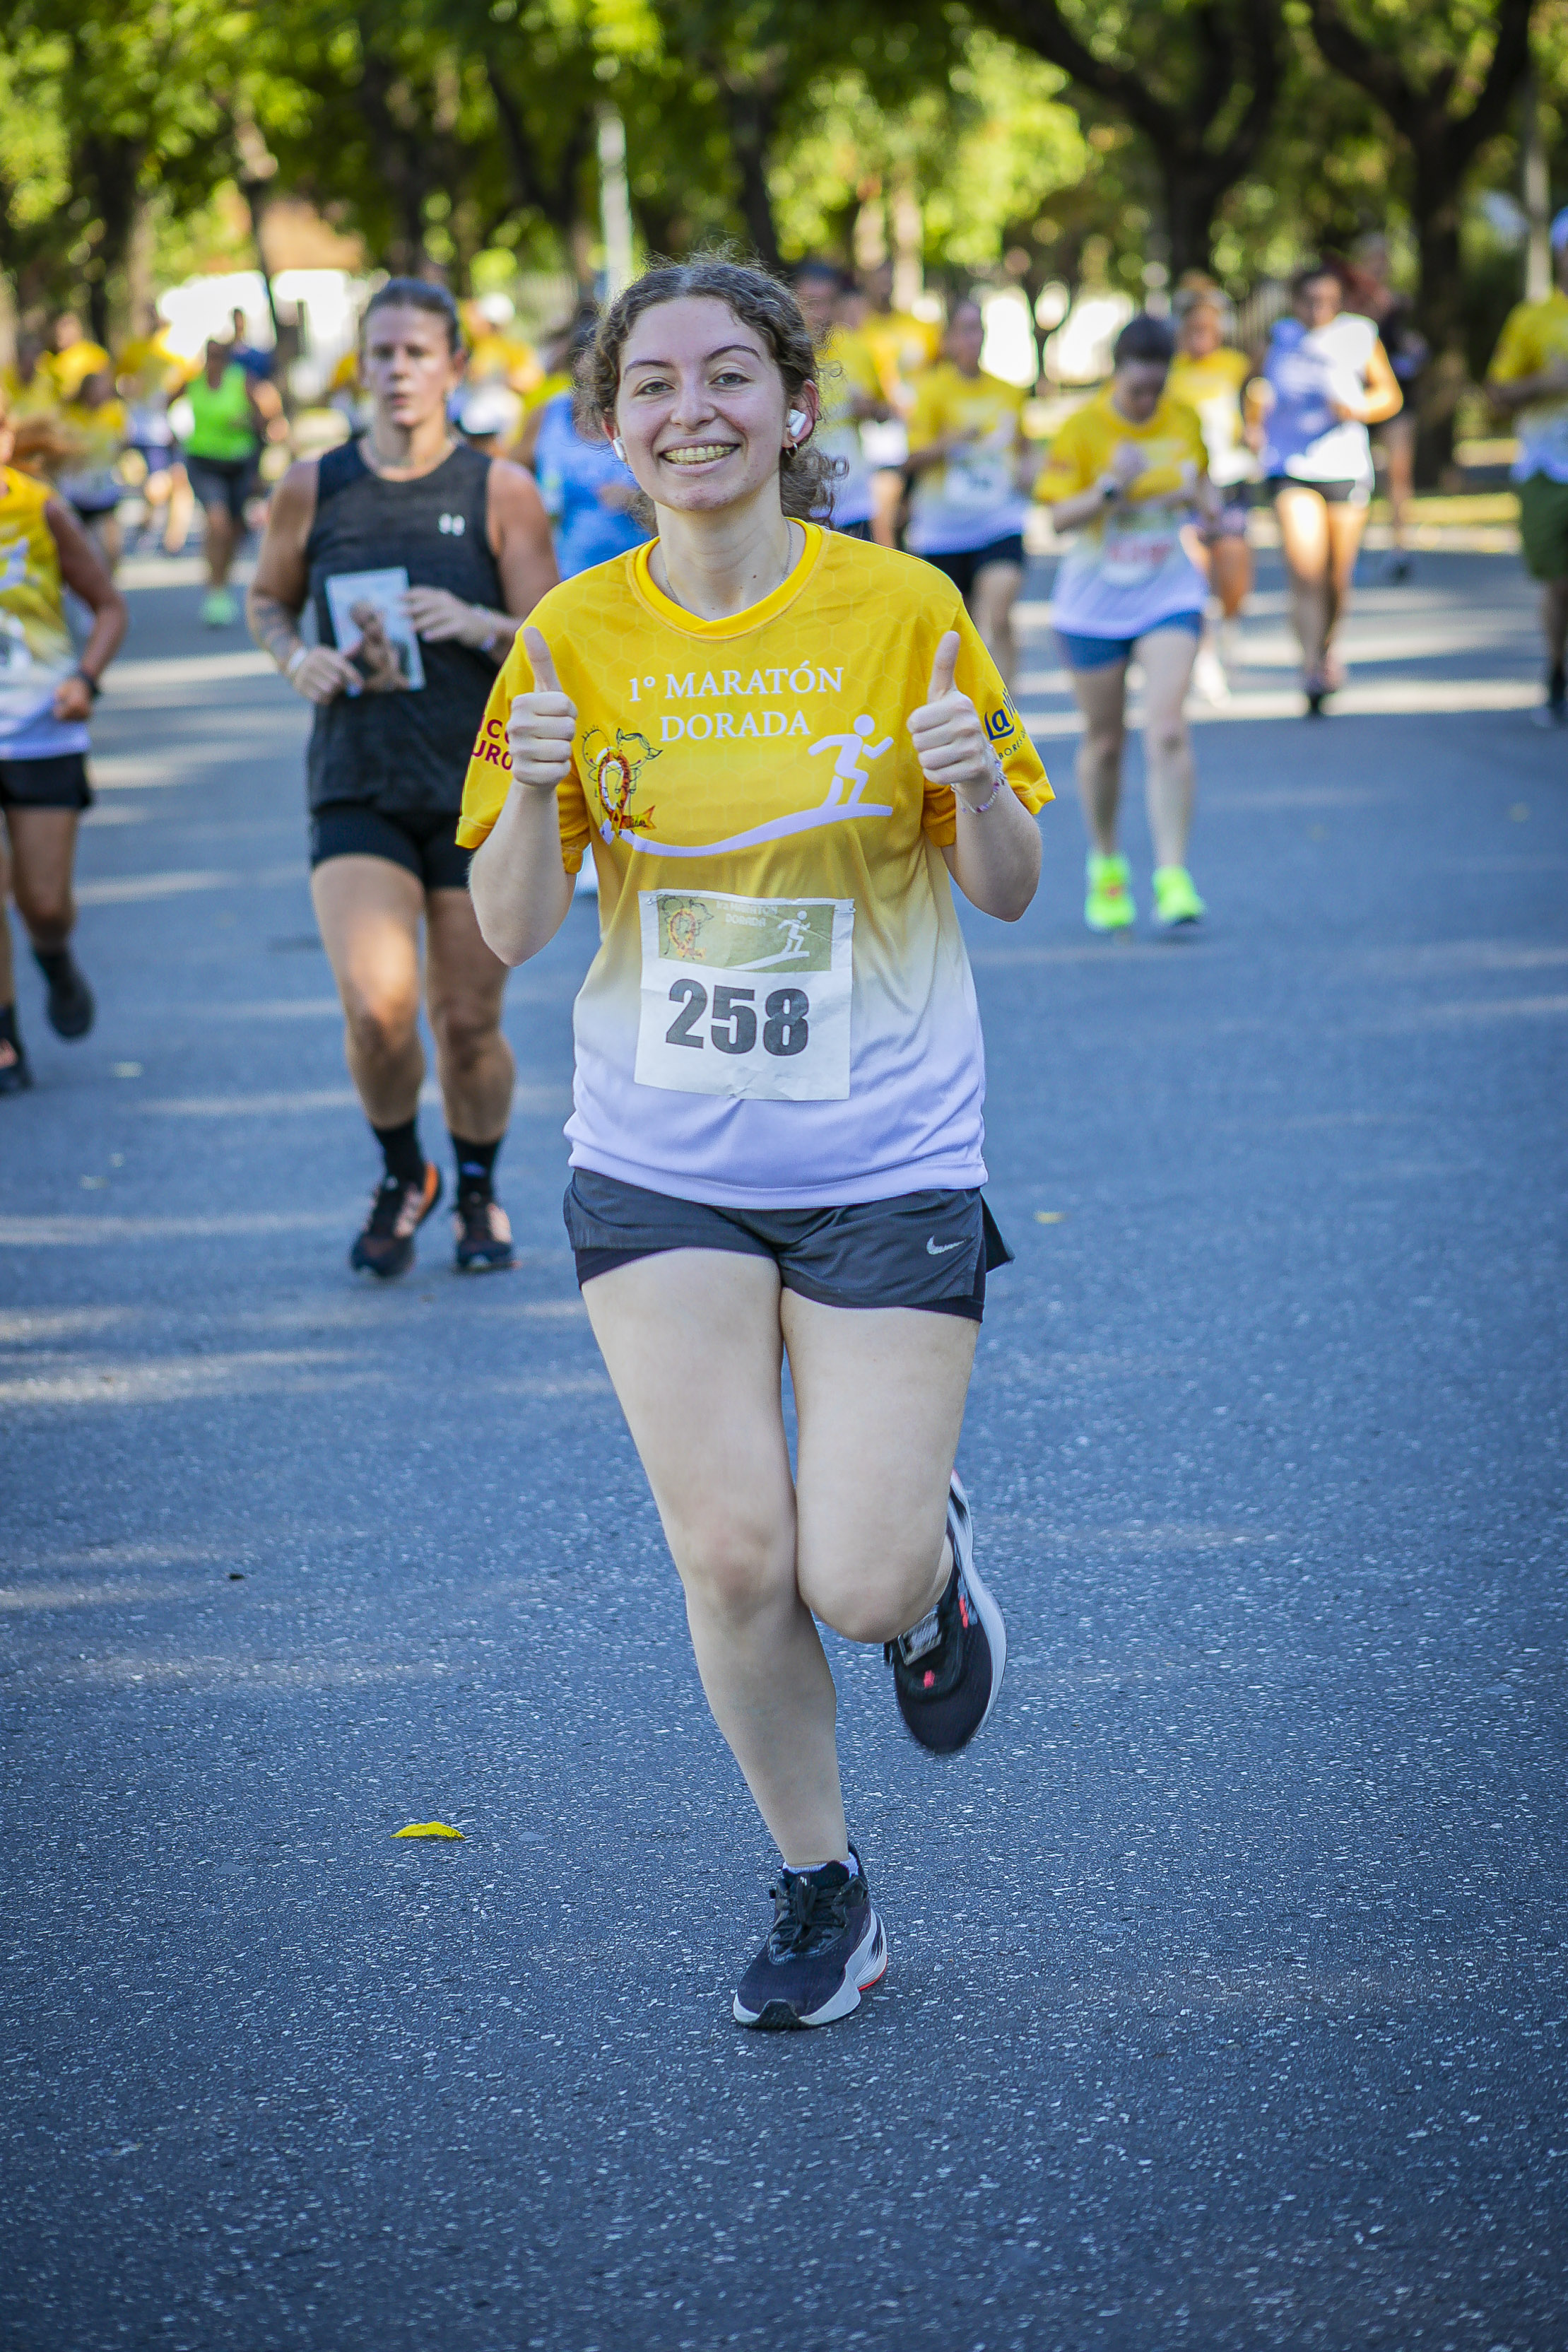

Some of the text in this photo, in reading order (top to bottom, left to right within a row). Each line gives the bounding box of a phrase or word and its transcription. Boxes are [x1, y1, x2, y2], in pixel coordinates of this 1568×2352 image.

[665, 660, 844, 698] MARATÓN
[660, 710, 811, 742] DORADA
[666, 978, 809, 1056] 258
